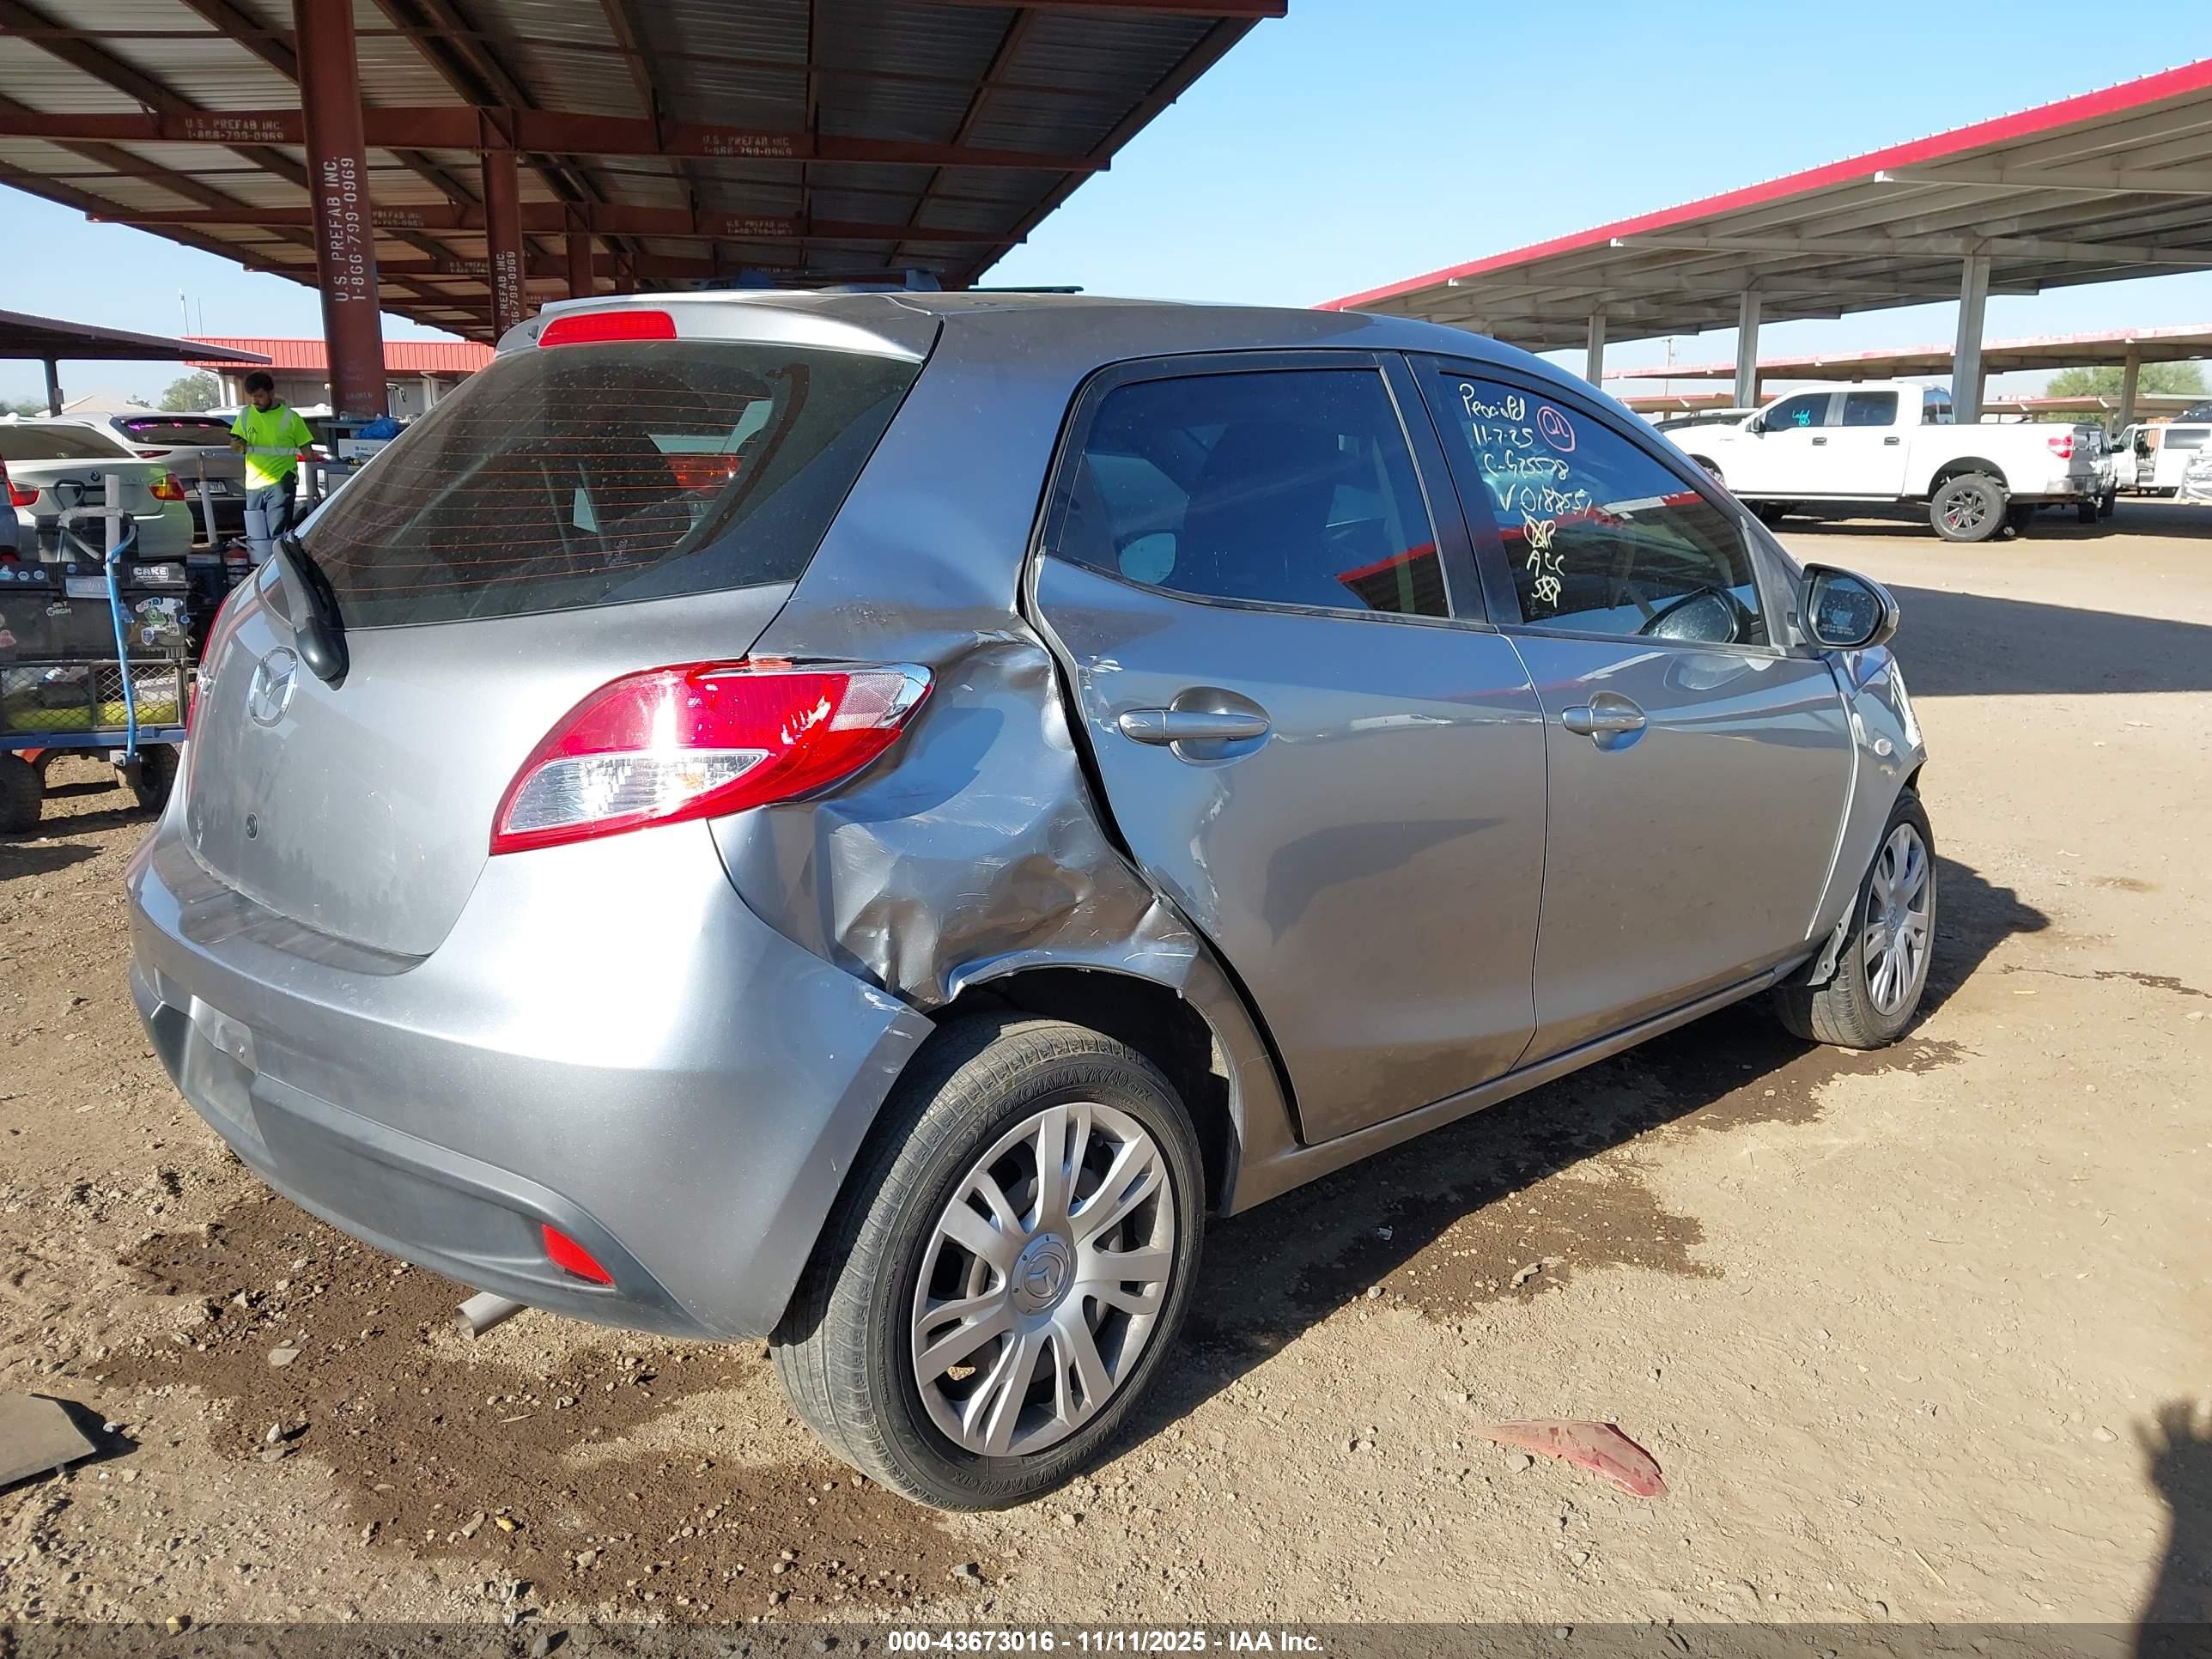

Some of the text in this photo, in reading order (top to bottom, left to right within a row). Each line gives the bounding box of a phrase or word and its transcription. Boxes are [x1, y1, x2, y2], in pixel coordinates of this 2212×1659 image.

[212, 119, 258, 131] PREFAB
[323, 156, 349, 302] U.S. PREFAB INC.
[340, 157, 368, 301] 1-866-799-0969
[495, 250, 507, 270] INC.
[497, 275, 509, 317] PREFAB
[990, 1067, 1081, 1121] YOKOHAMA
[1081, 1065, 1129, 1087] YK740
